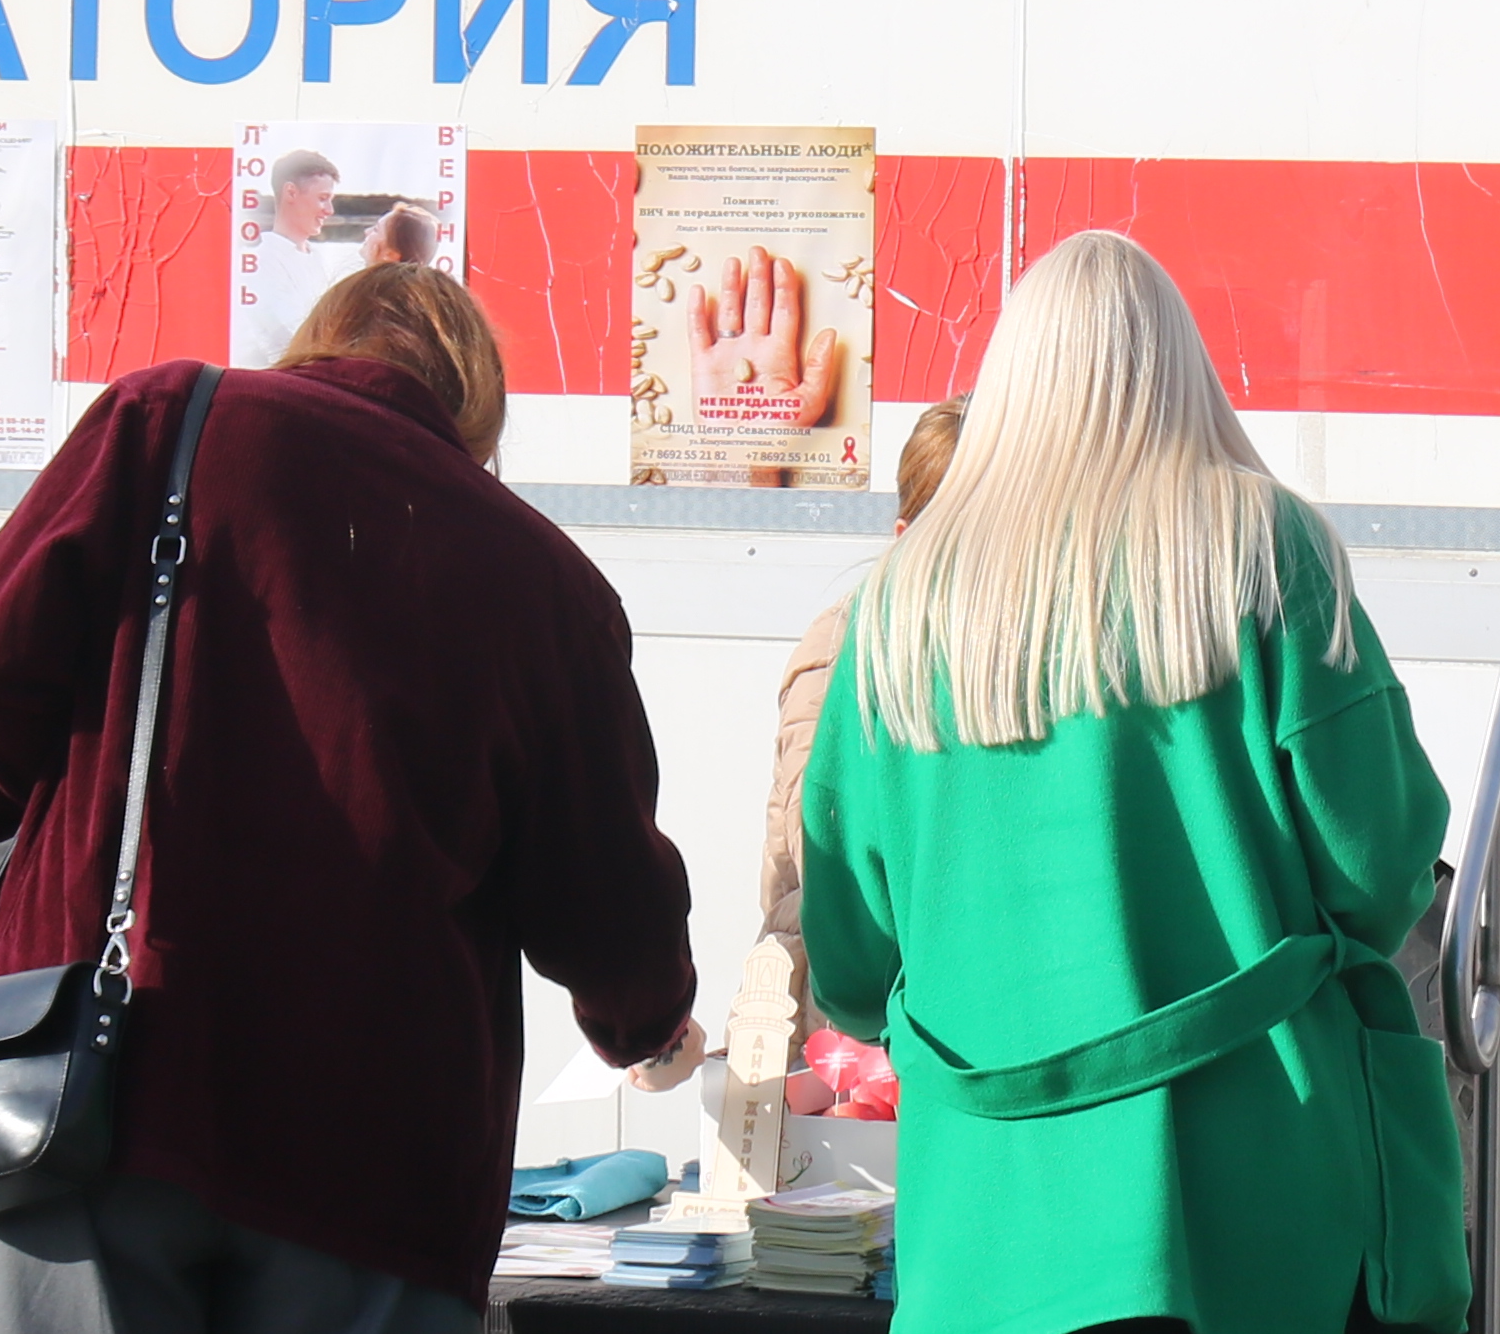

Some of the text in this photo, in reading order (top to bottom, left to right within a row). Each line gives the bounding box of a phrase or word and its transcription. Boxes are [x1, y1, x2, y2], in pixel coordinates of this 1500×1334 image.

[636, 143, 802, 157] ПОЛОЖИТЕЛЬНЫЕ
[723, 197, 780, 207] Помните:
[236, 125, 266, 305] ЛЮБОВЬ
[639, 208, 866, 221] ВИЧ не передается через рукопожатие
[736, 385, 765, 395] ВИЧ
[700, 398, 801, 409] НЕ ПЕРЕДАЕТСЯ
[699, 410, 802, 422] ЧЕРЕЗ ДРУЖБУ
[660, 424, 812, 437] СПИД Центр Севастополя
[641, 450, 728, 461] +7 8692 55 21 82
[745, 452, 832, 463] +7 8692 55 14 01
